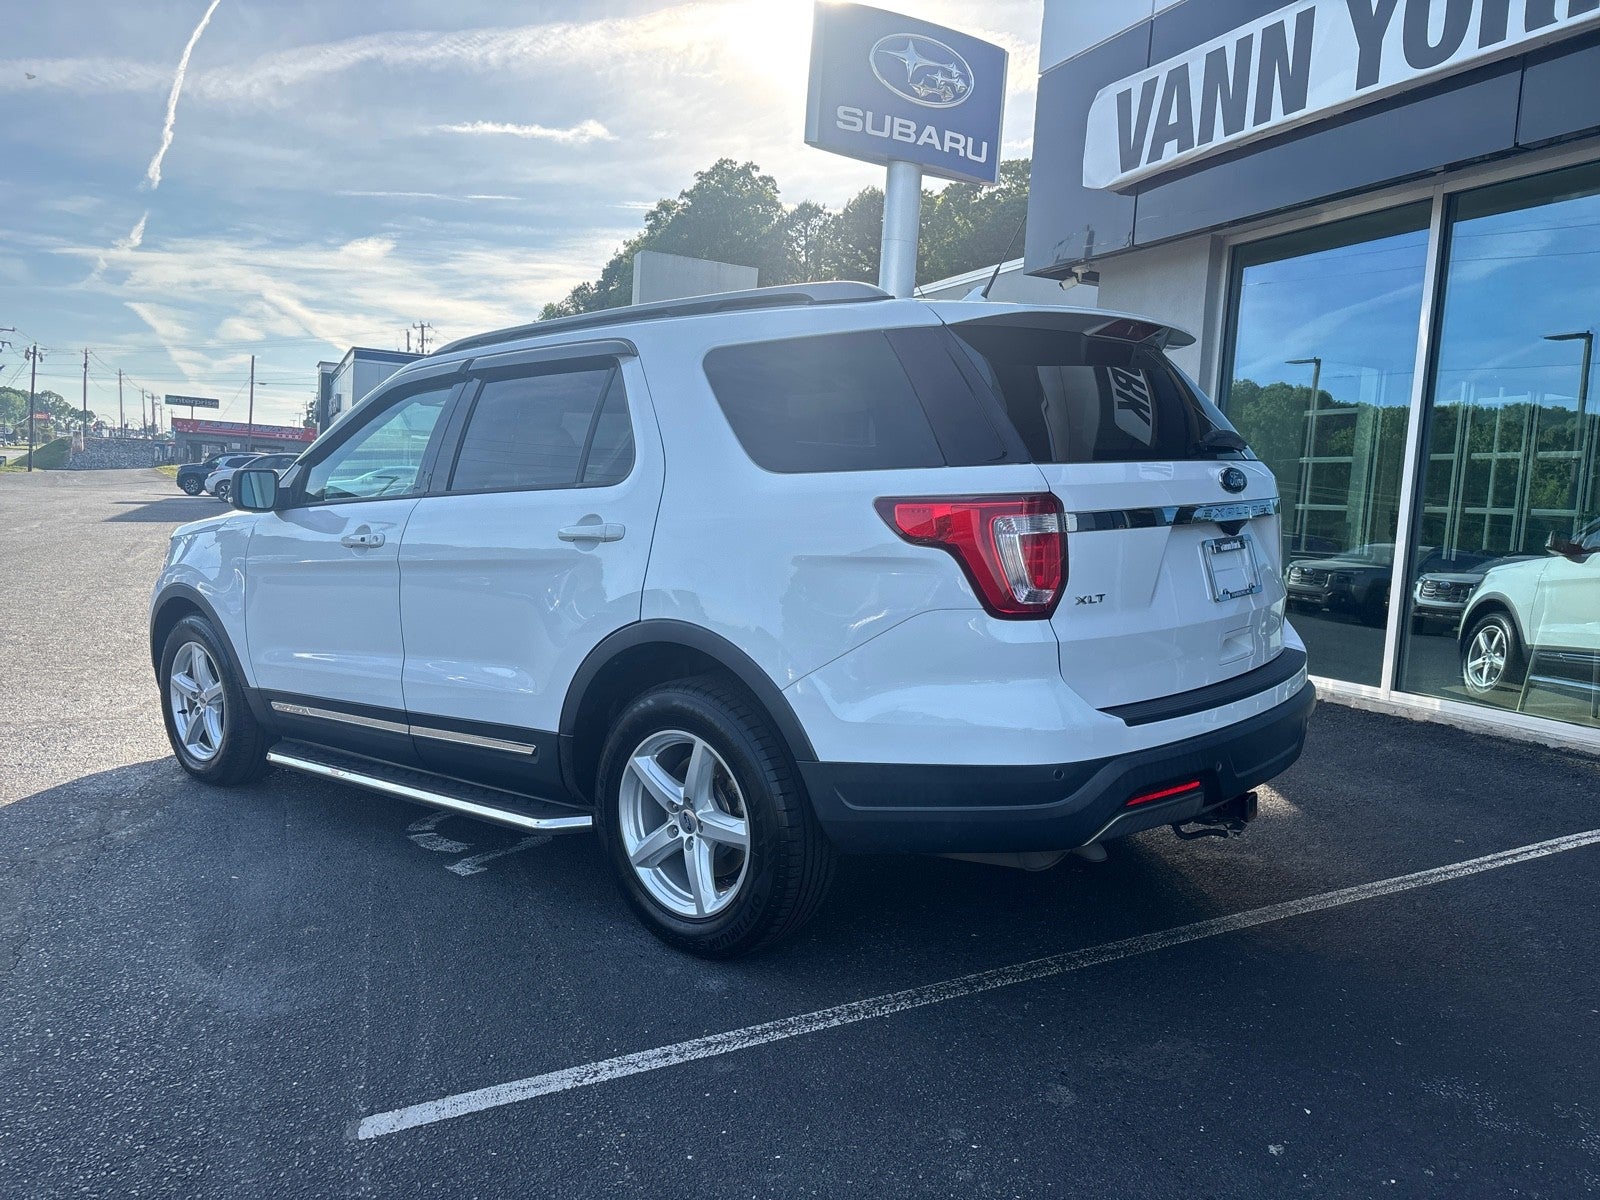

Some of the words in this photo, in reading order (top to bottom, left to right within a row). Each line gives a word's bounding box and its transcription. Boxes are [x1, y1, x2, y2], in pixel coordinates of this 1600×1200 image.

[1116, 5, 1316, 174] VANN
[1346, 0, 1600, 91] YO
[836, 105, 988, 164] SUBARU
[1075, 593, 1106, 605] XLT
